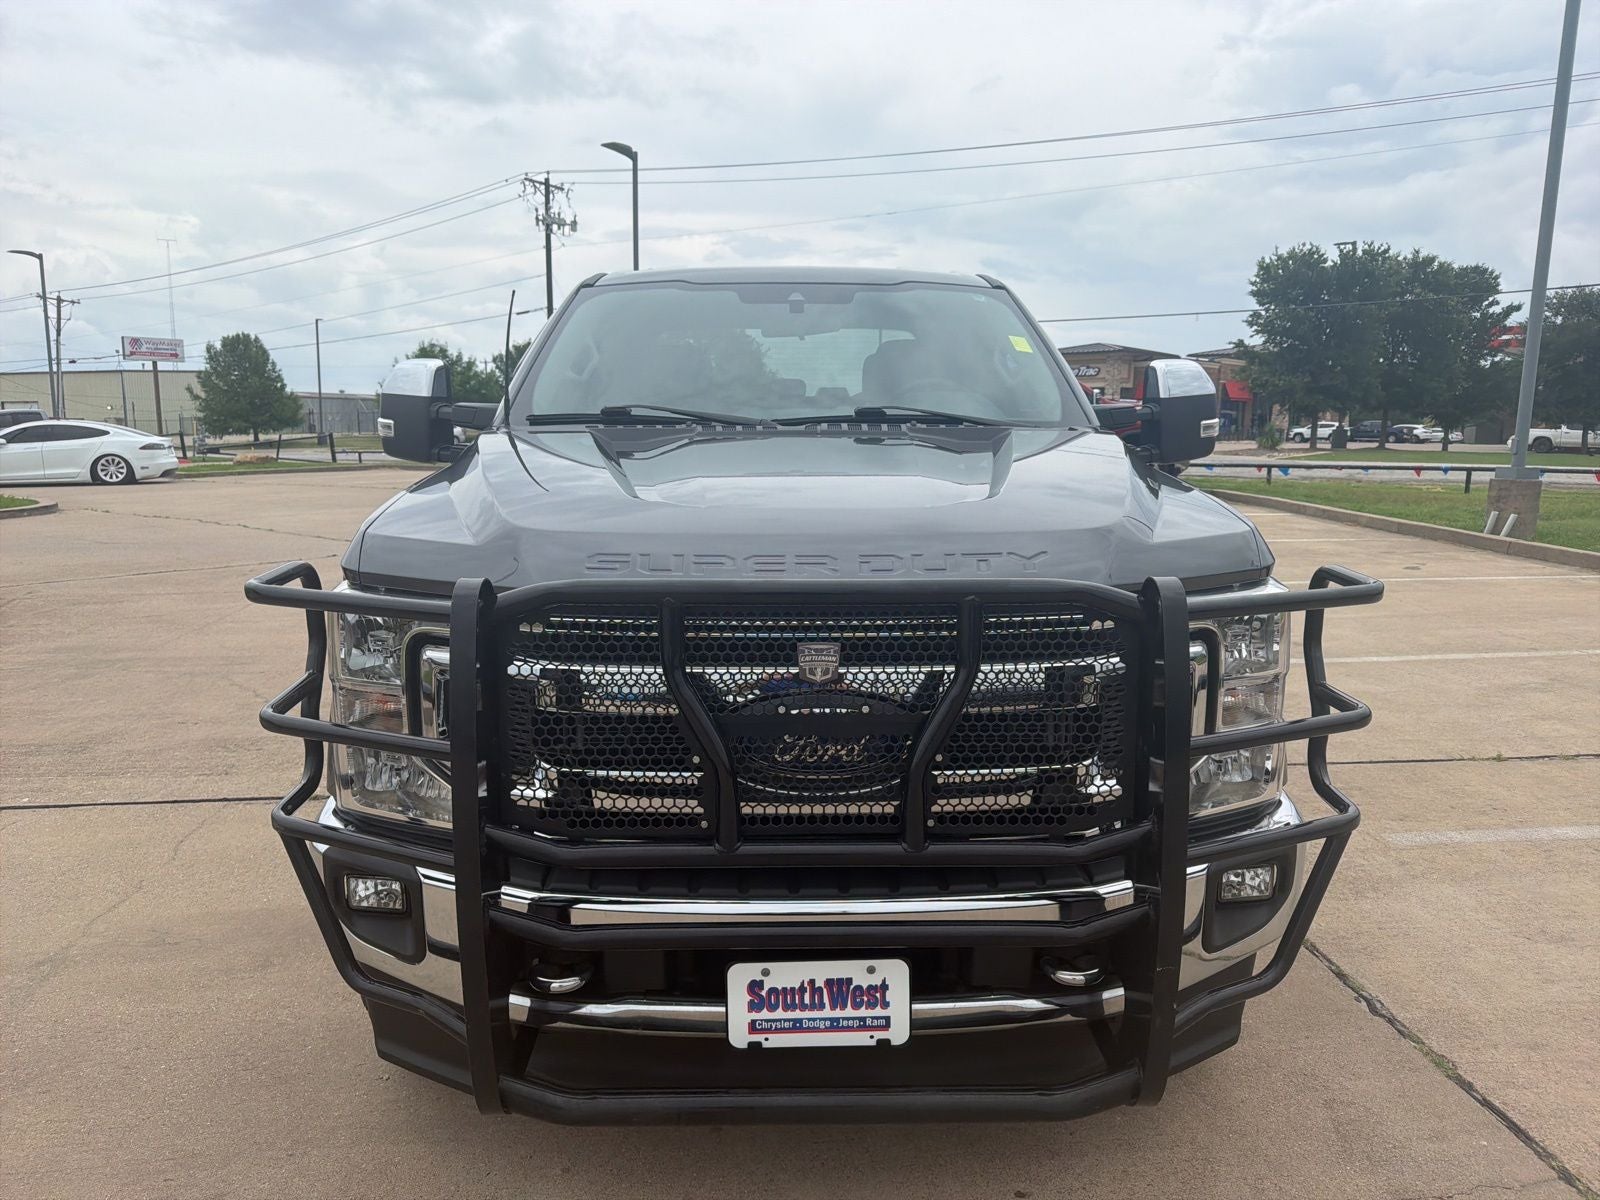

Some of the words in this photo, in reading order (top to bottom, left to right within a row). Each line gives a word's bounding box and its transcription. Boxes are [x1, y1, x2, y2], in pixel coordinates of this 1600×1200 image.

[143, 339, 180, 348] WayMaker
[584, 552, 839, 576] SUPER
[857, 551, 1049, 576] DUTY
[747, 976, 890, 1014] SouthWest
[755, 1019, 794, 1031] Chrysler
[802, 1018, 831, 1030] Dodge
[838, 1018, 860, 1029] Jeep
[865, 1017, 886, 1027] Ram
